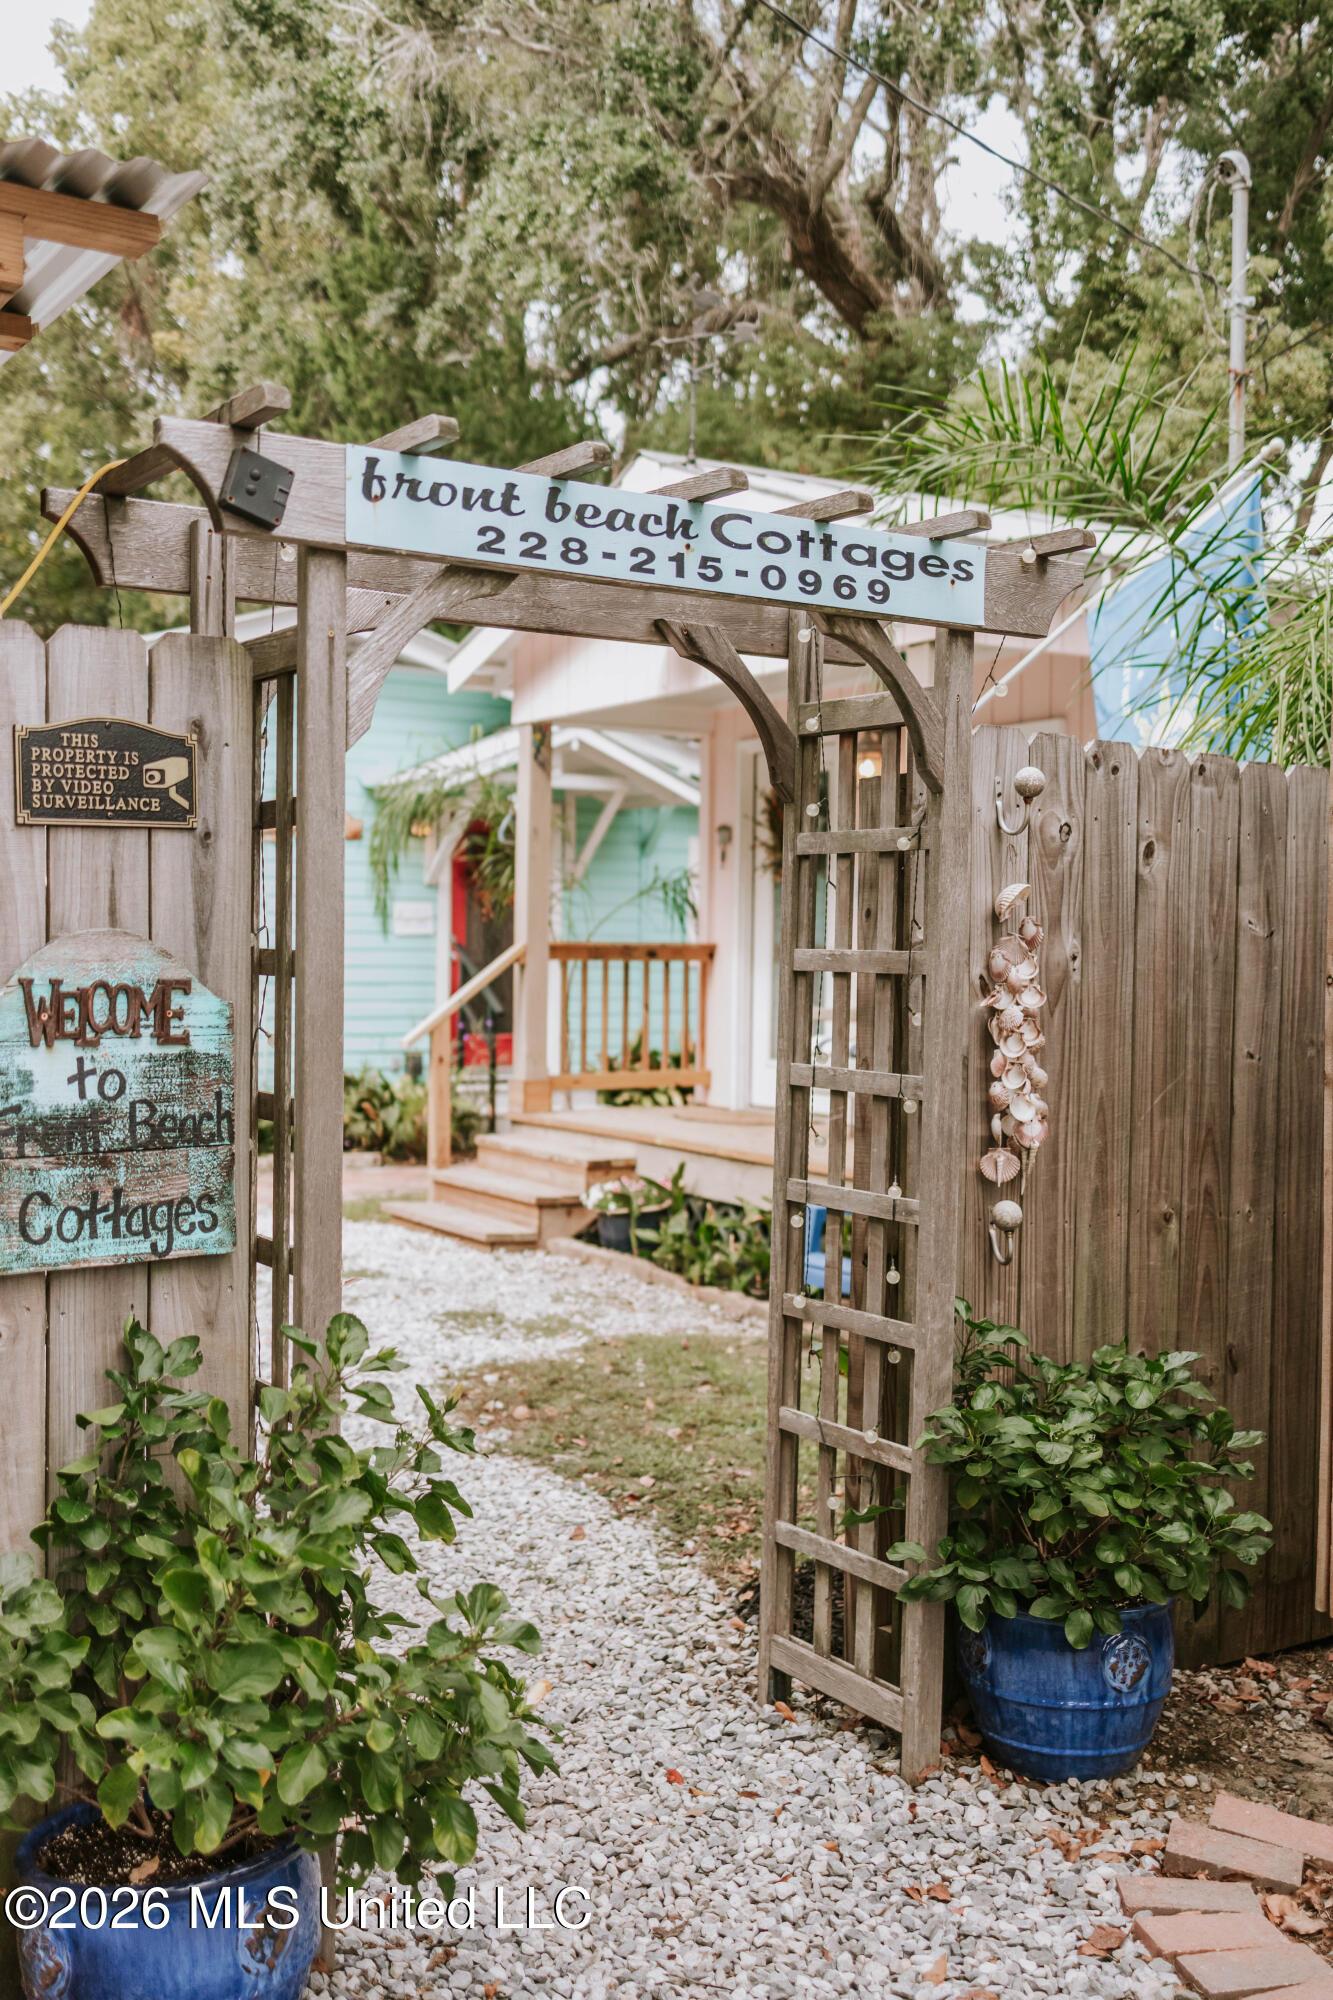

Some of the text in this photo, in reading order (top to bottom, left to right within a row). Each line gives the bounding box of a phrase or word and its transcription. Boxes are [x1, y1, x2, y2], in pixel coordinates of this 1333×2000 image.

[361, 457, 975, 582] front beach Cottages
[476, 525, 891, 605] 228-215-0969
[31, 747, 140, 765] PROPERTY IS
[60, 732, 99, 748] THIS
[31, 763, 130, 780] PROTECTED
[32, 779, 114, 795] BY VIDEO
[32, 794, 161, 812] SURVEILLANCE
[18, 977, 192, 1047] WELCOME
[67, 1056, 127, 1102] to
[129, 1090, 234, 1149] Beach
[18, 1186, 219, 1258] Cottages
